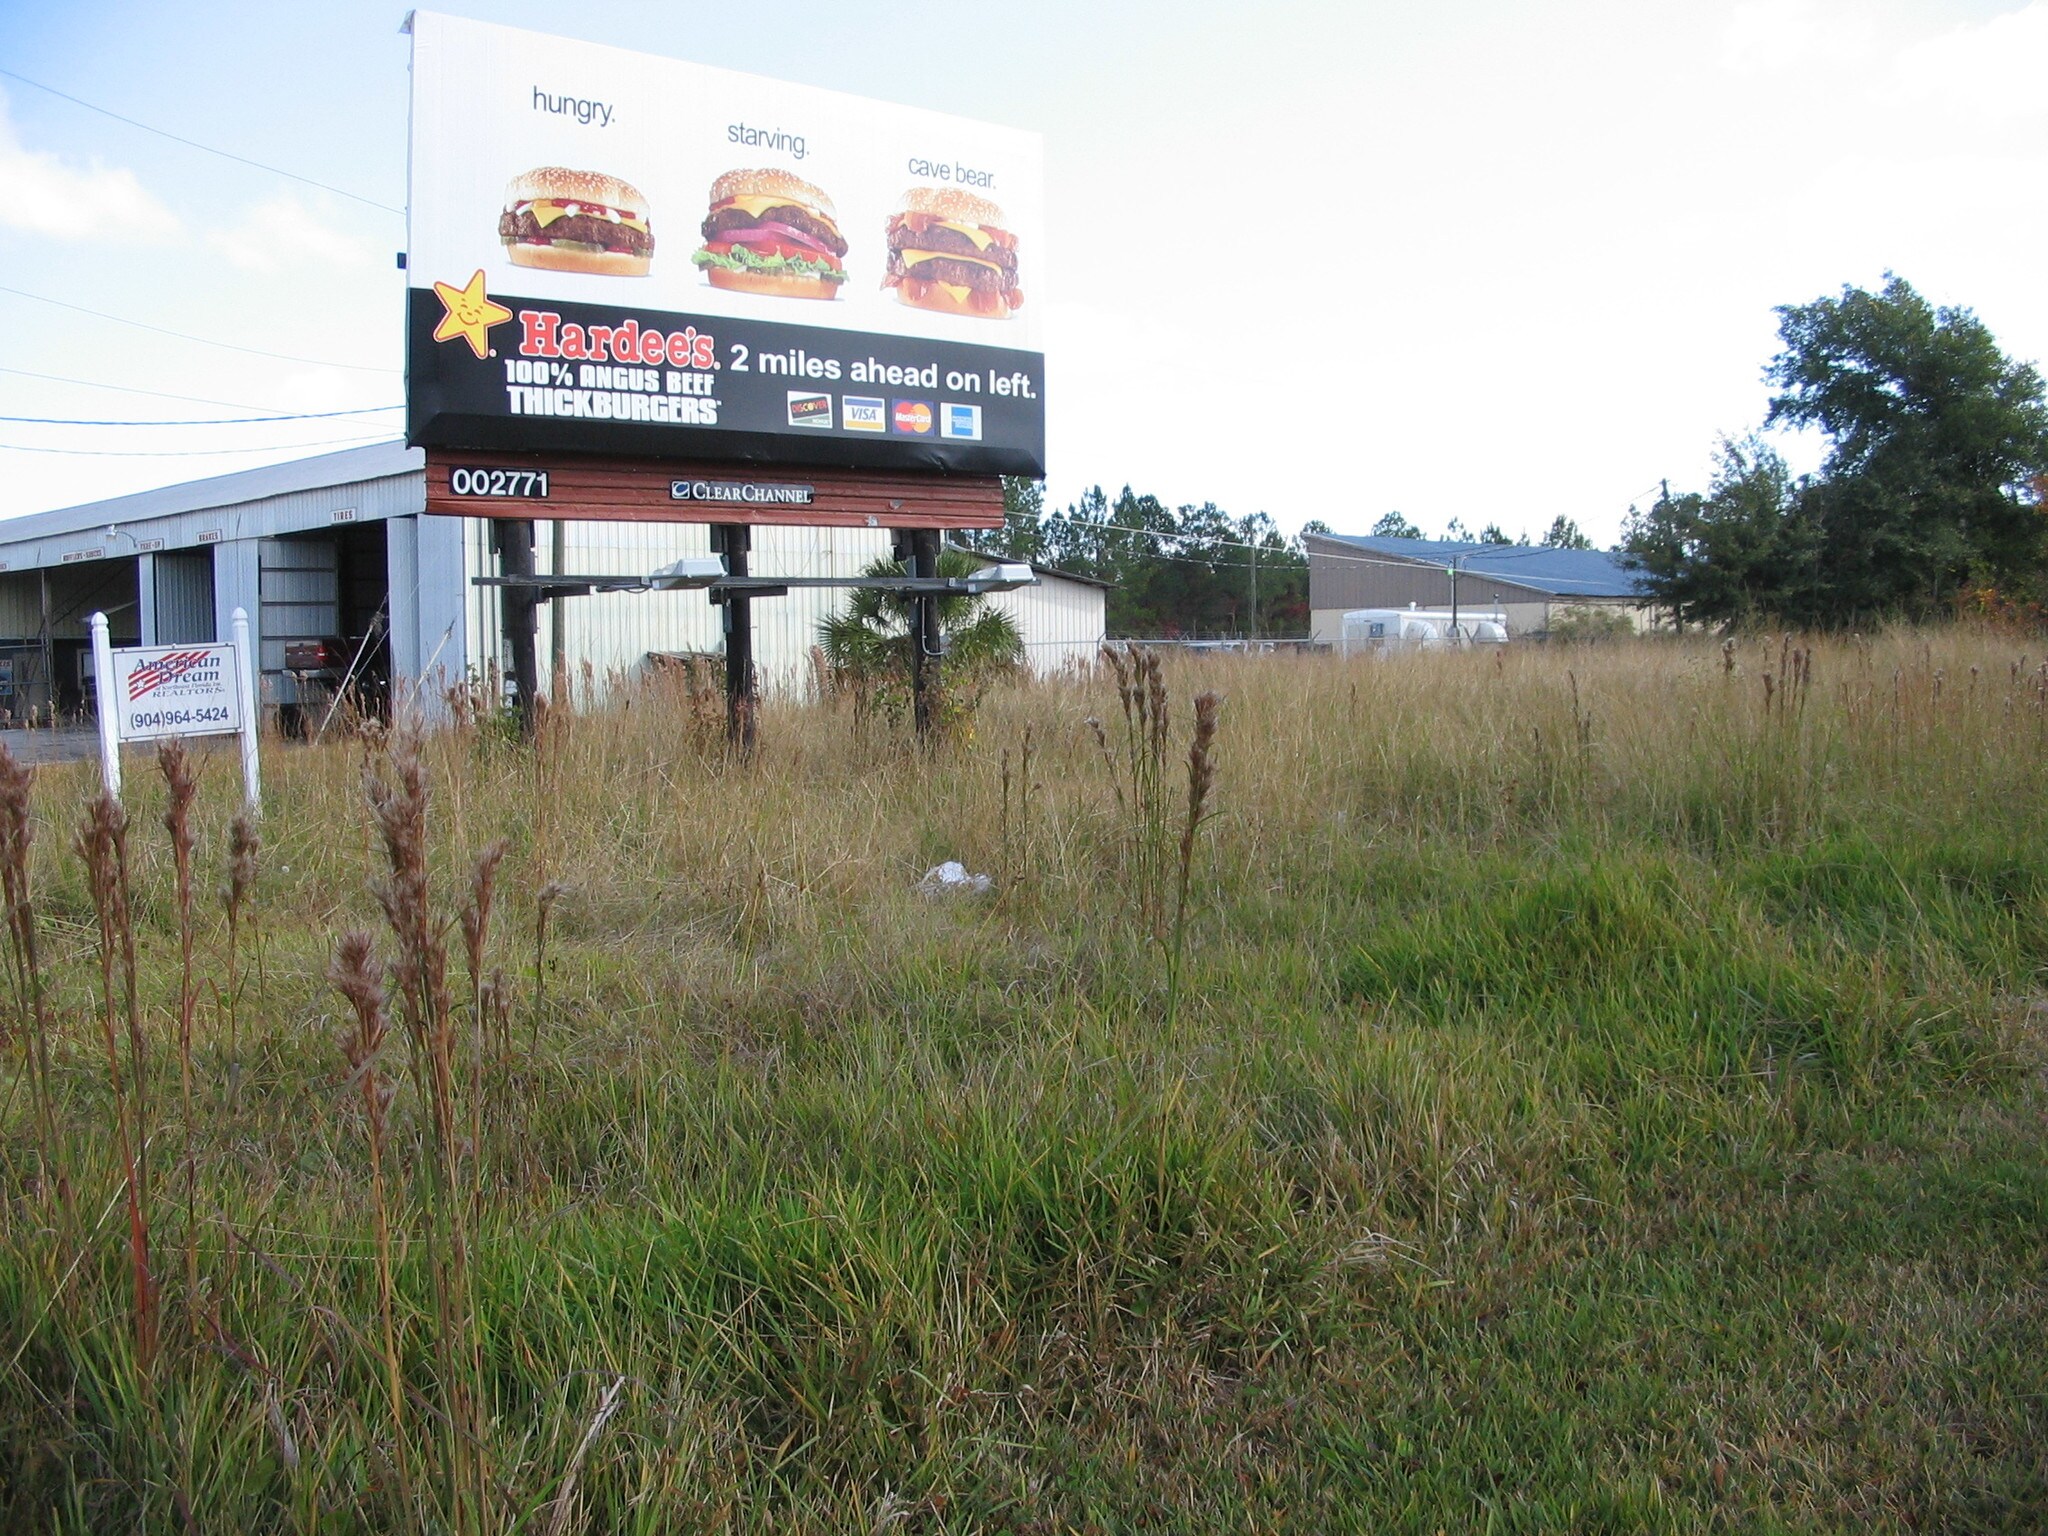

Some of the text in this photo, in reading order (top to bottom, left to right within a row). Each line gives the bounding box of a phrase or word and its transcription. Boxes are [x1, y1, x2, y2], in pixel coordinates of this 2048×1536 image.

[533, 85, 616, 127] hungry.
[727, 122, 810, 159] starving.
[908, 157, 996, 190] cave bear.
[518, 310, 715, 370] Hardee's
[504, 359, 715, 396] 100% ANGUS BEEF
[730, 343, 1037, 399] 2 miles ahead on left.
[506, 386, 718, 425] THICKBURGERS
[791, 399, 827, 413] DISCOVER
[851, 406, 877, 421] VISA
[895, 412, 931, 423] MasterCard
[452, 468, 548, 496] 002771
[333, 510, 353, 521] TIRES
[134, 656, 221, 672] American
[159, 670, 219, 684] Dream
[130, 706, 229, 730] (904)964-5424
